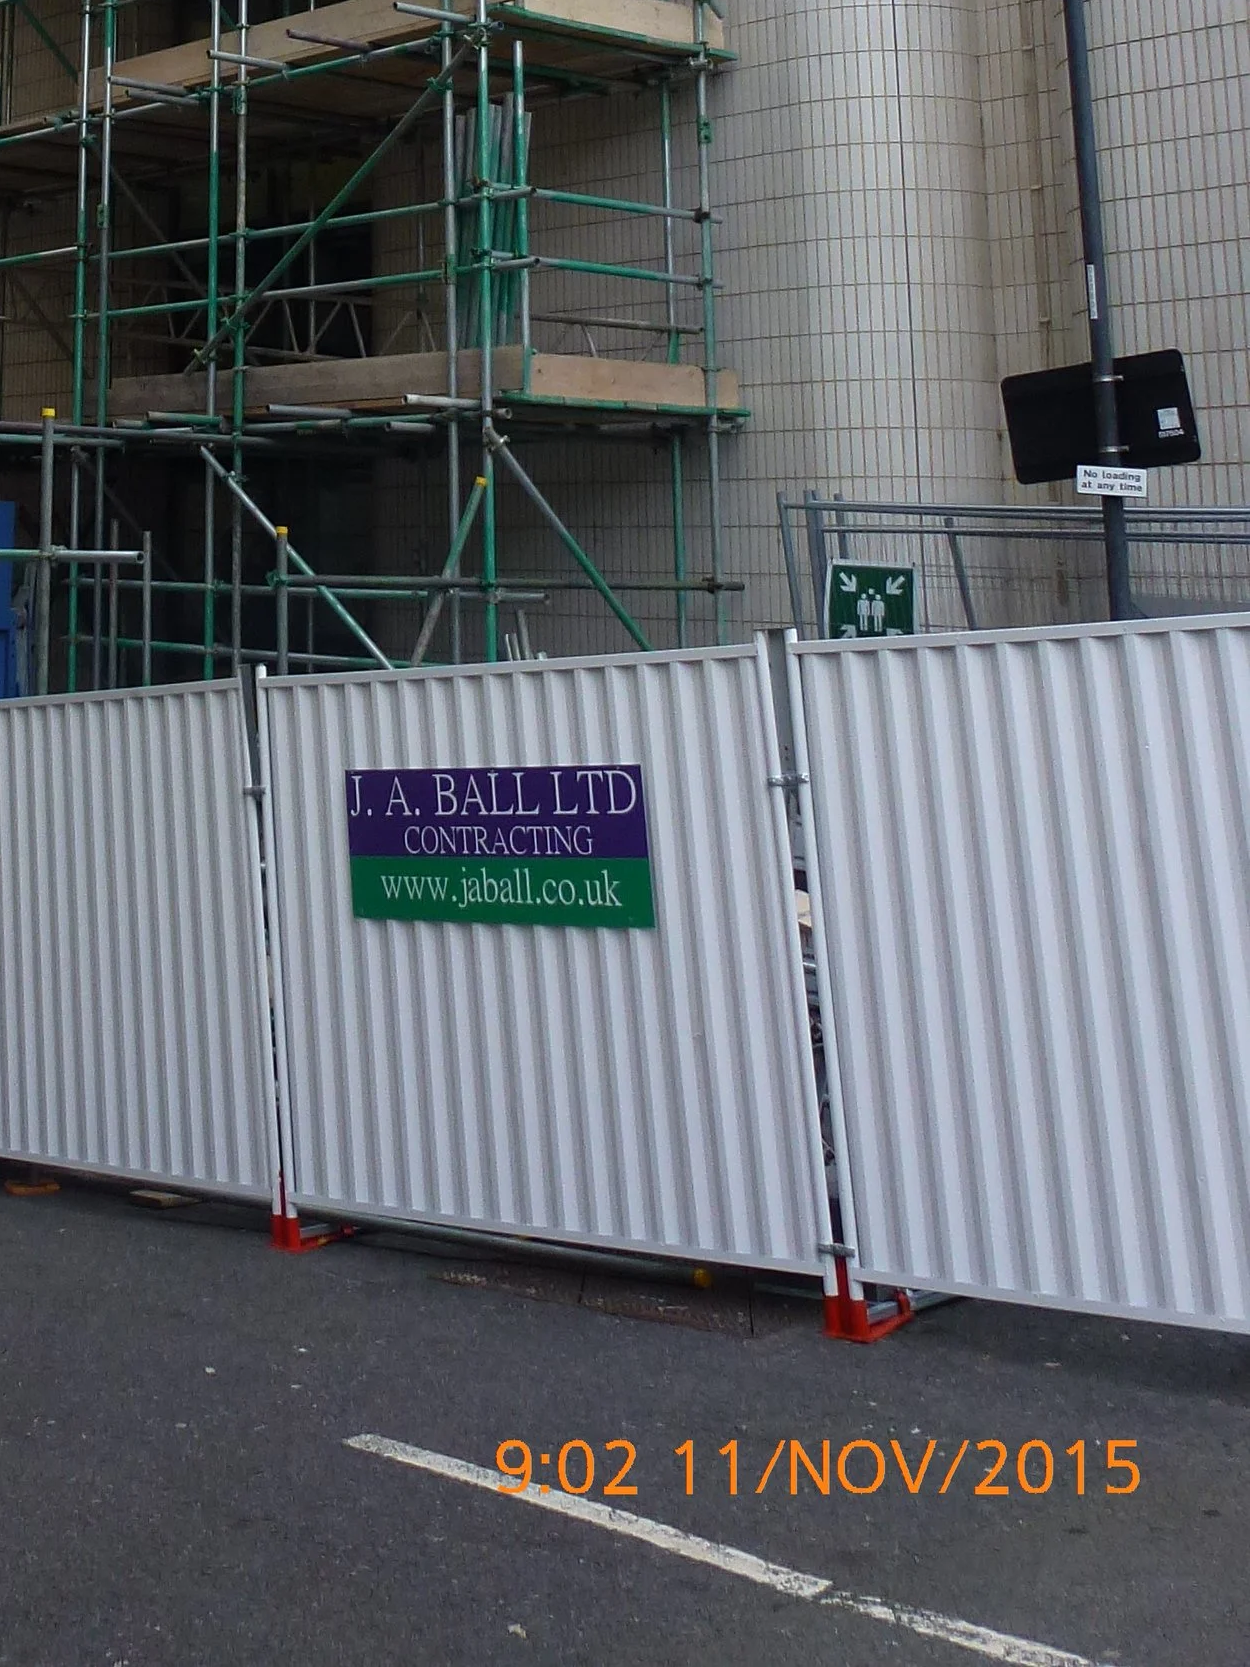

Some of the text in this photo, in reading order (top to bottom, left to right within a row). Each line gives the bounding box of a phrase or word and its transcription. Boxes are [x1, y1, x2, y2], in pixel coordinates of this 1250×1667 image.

[1081, 481, 1143, 492] at any time
[1083, 469, 1142, 483] No loading
[350, 769, 638, 817] J. A. BALL LTD
[404, 825, 594, 856] CONTRACTING
[380, 866, 623, 909] www.jaball.co.uk
